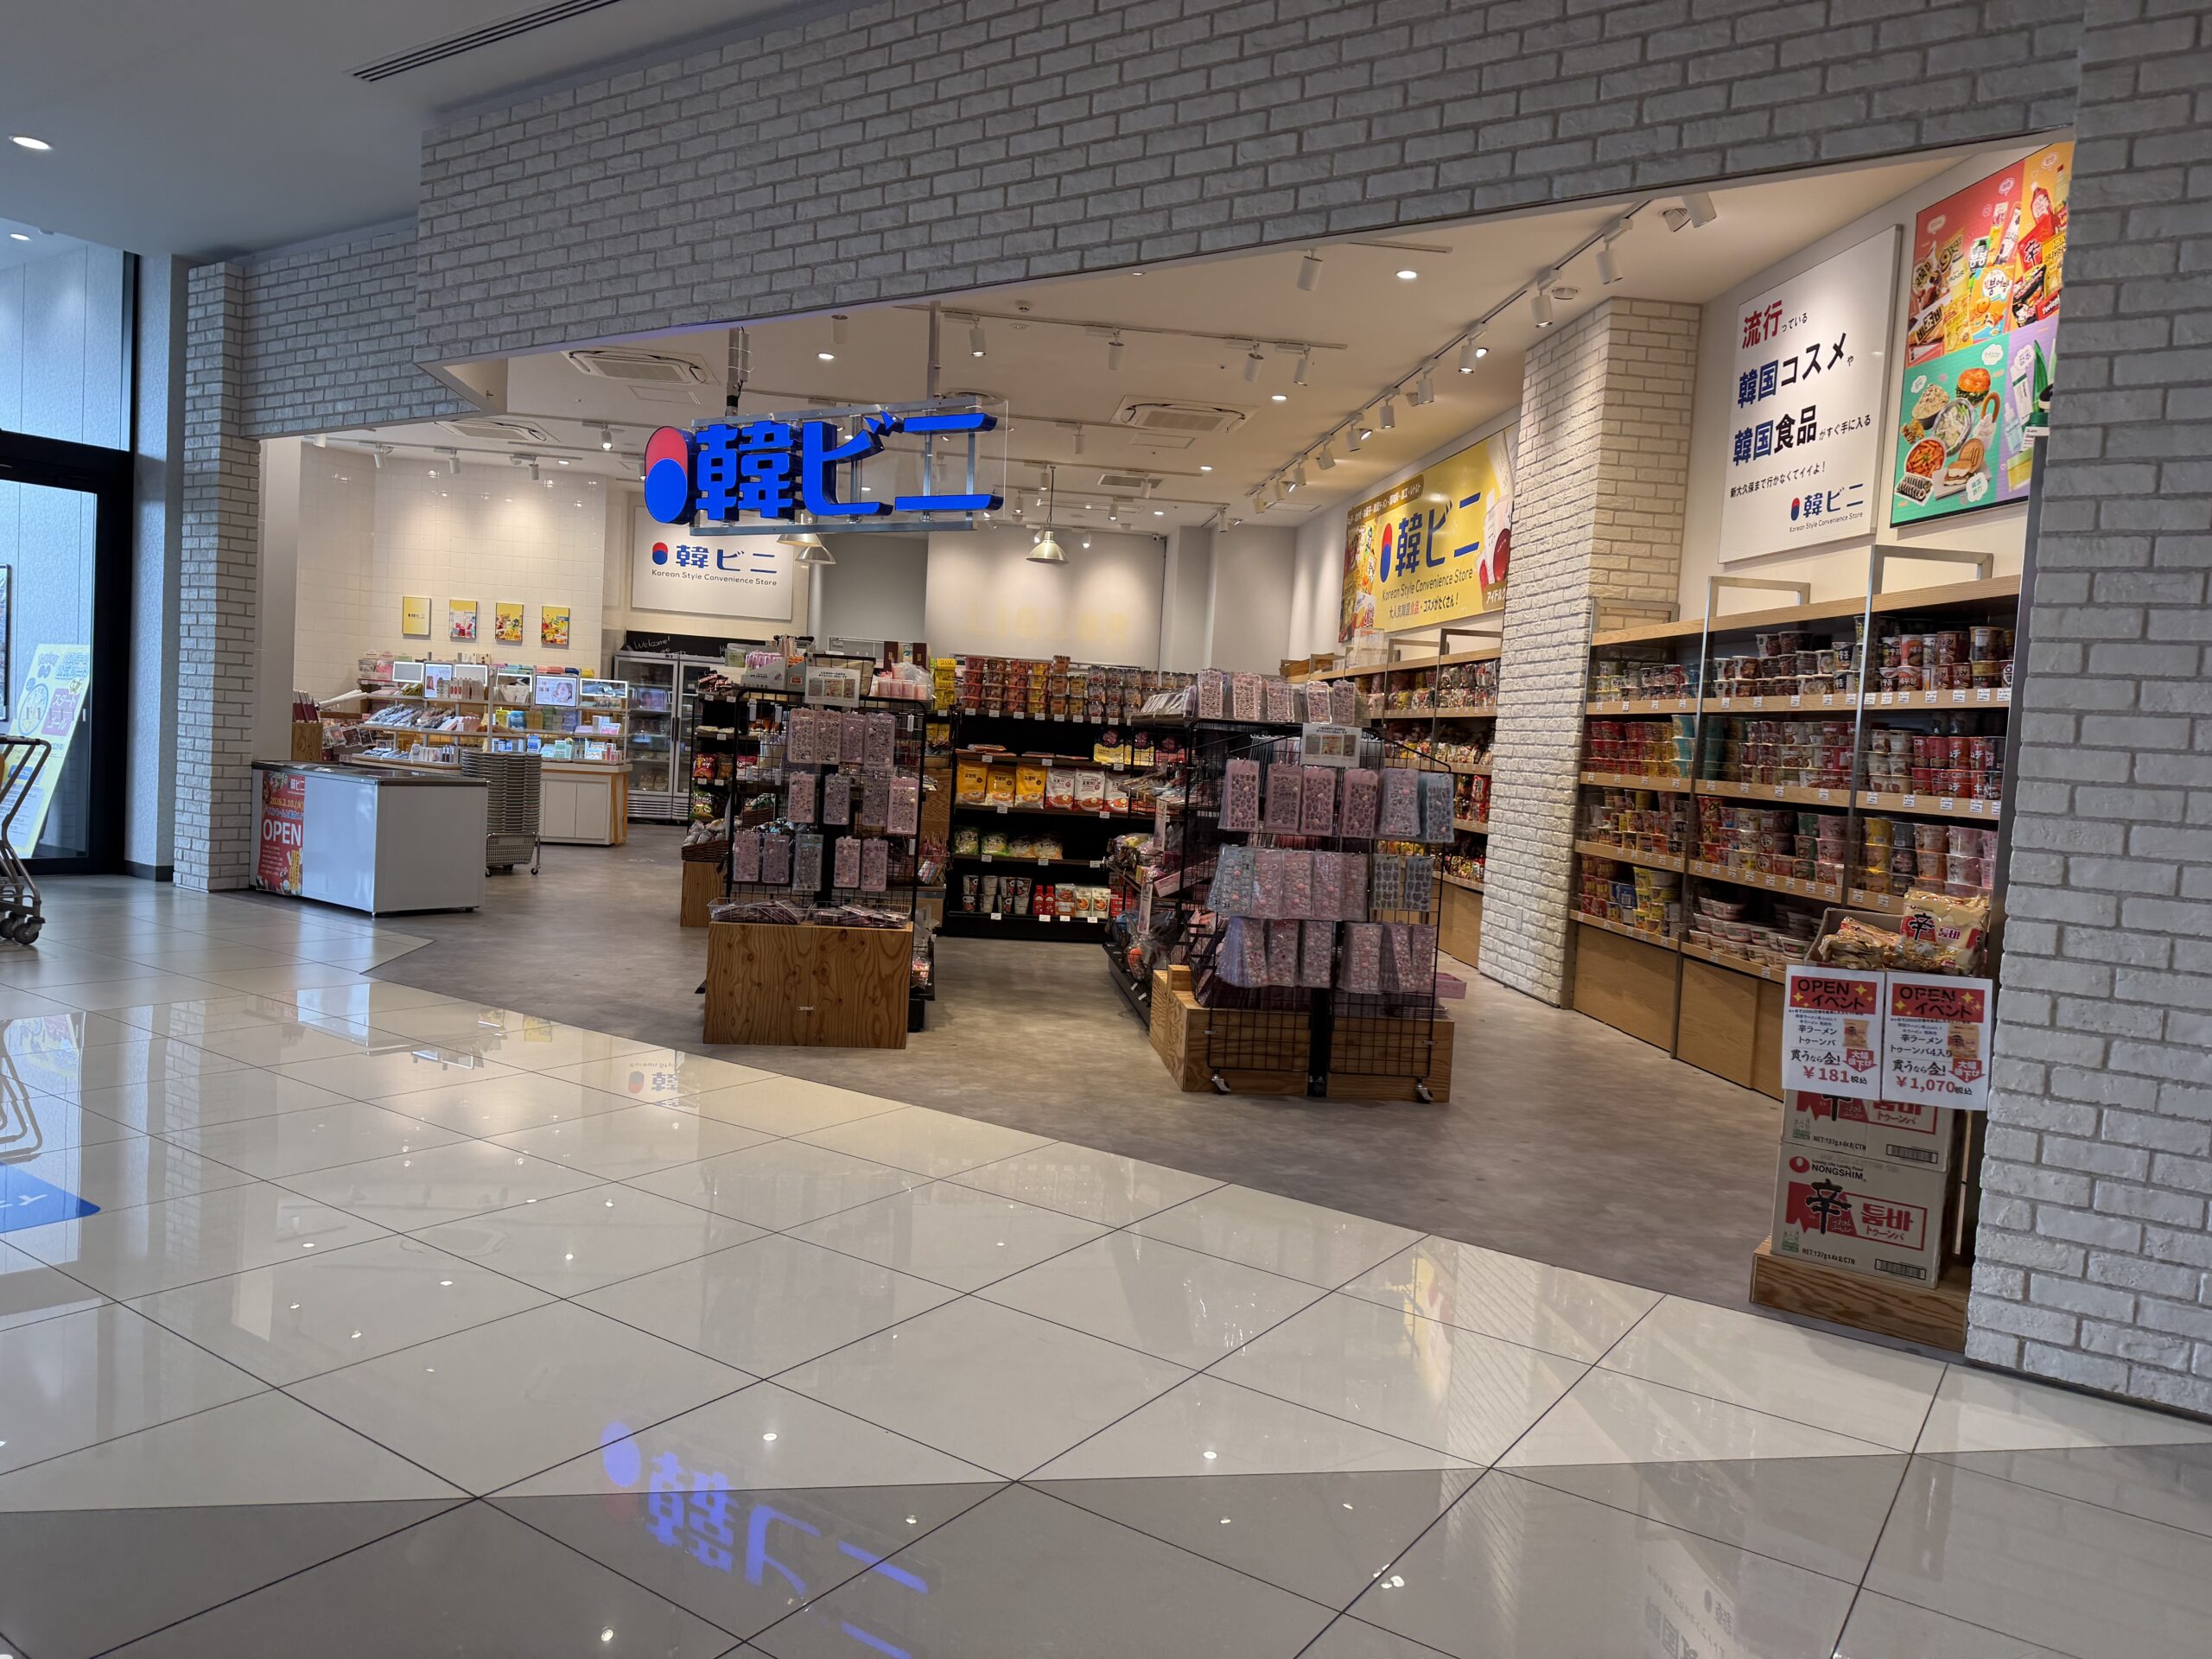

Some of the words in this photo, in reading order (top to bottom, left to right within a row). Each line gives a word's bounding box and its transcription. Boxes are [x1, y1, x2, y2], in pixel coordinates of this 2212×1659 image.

[1742, 299, 1808, 349] 流行っている
[1738, 333, 1854, 409] 韓国コスメや
[1732, 404, 1872, 467] 韓国食品がすぐ手に入る
[696, 411, 1003, 520] 韓ビニ
[1730, 461, 1826, 498] 新大久保まで行かなくてイイよ！
[1803, 483, 1864, 518] 韓ビニ
[1789, 524, 1805, 533] Korean
[1806, 521, 1818, 530] Style
[1819, 516, 1848, 527] Convenience
[1849, 512, 1863, 521] Store
[1395, 492, 1481, 577] 韓ビニ
[676, 544, 778, 575] 韓ビニ
[652, 569, 680, 578] Korean
[682, 572, 702, 581] Style
[704, 574, 753, 584] Convenience
[1382, 584, 1401, 601] Korean
[1401, 582, 1415, 599] Style
[1415, 573, 1453, 593] Convenience
[1453, 568, 1473, 583] Store
[47, 715, 67, 730] ゴール
[263, 819, 302, 846] OPEN
[1909, 912, 1936, 941] 辛
[1798, 979, 1850, 995] OPEN
[1900, 987, 1955, 1003] OPEN
[1812, 995, 1865, 1009] イベント
[1915, 1002, 1972, 1019] イベント
[1799, 1025, 1838, 1035] 辛ラーメン
[1799, 1036, 1836, 1046] トゥーンバ
[1901, 1034, 1943, 1045] 辛ラーメン
[1790, 1049, 1840, 1065] 買うなら今！
[1891, 1045, 1953, 1058] トゥーンバ4入り
[1892, 1059, 1946, 1077] 買うなら今！
[1878, 1111, 1916, 1125] トゥーンバ
[1811, 1164, 1863, 1180] NONGSHIM
[1805, 1179, 1852, 1235] 辛
[1866, 1227, 1905, 1241] トゥーンバ
